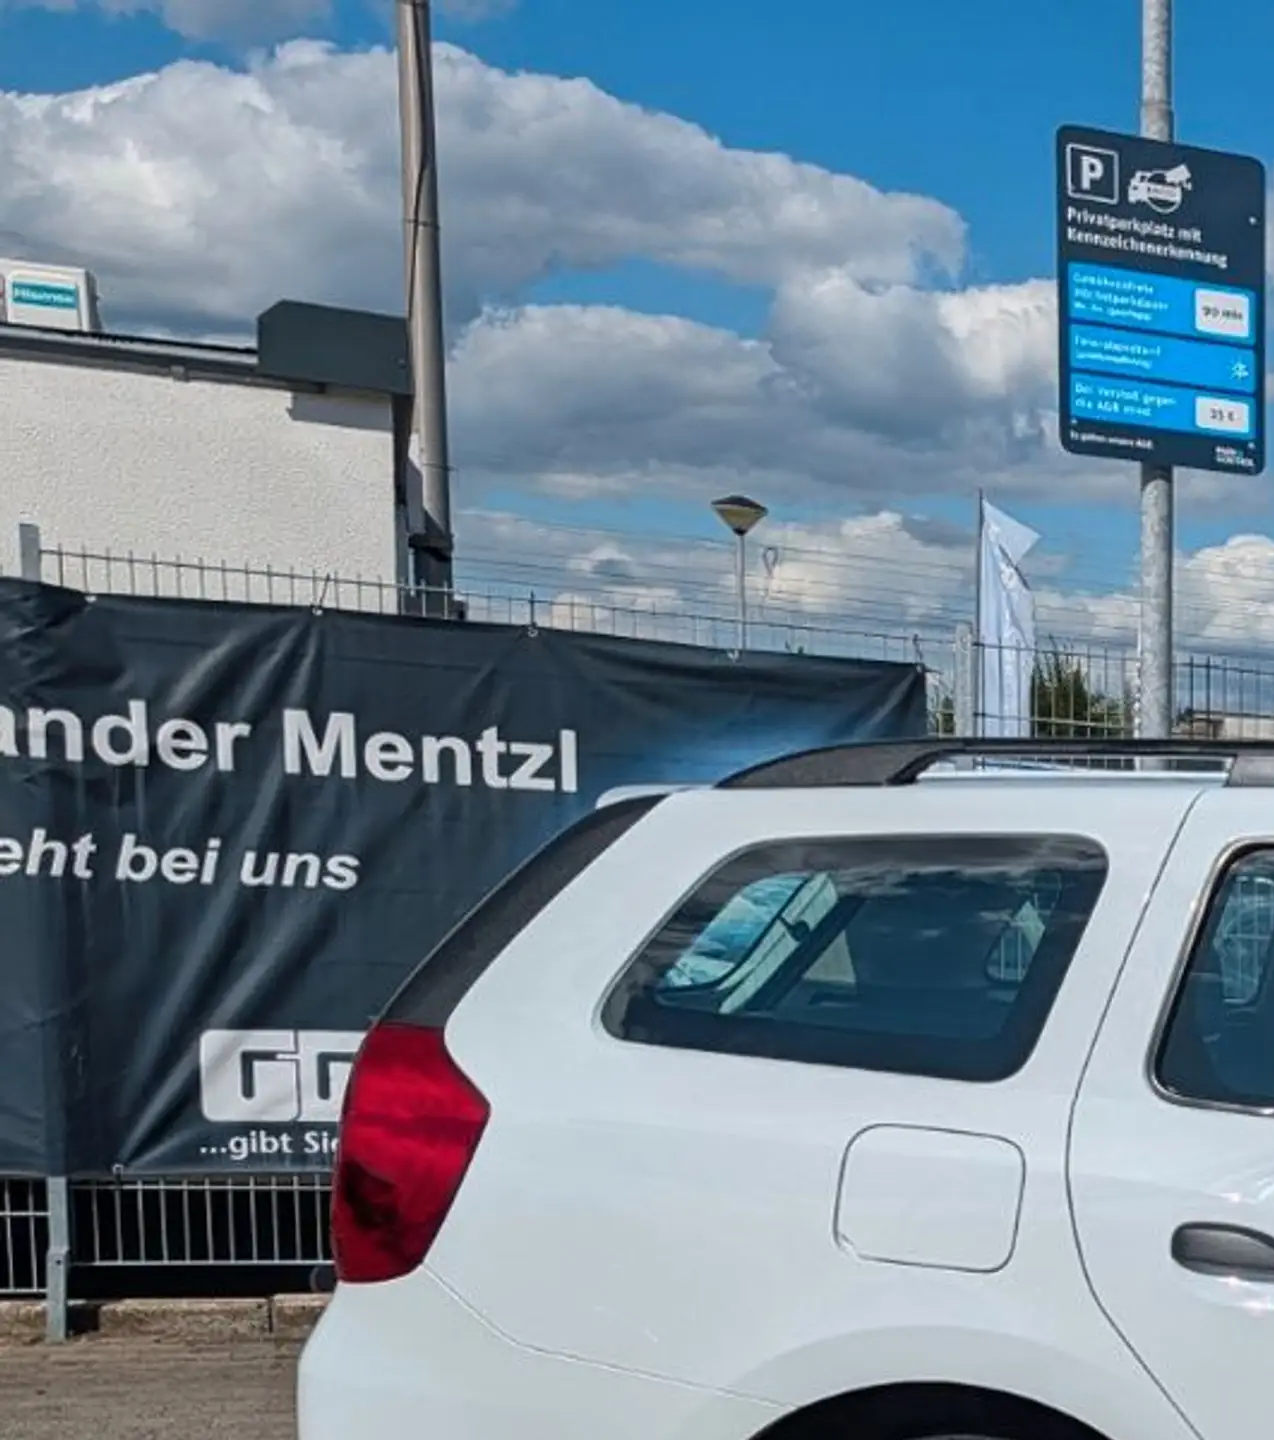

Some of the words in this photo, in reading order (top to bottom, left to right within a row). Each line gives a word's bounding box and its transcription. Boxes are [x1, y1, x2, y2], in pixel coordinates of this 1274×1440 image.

[1081, 155, 1104, 190] P
[1067, 206, 1175, 239] Privatparkplatz
[1178, 227, 1202, 243] mit
[1067, 226, 1228, 269] Kennzeichenerkennung
[283, 708, 577, 793] Mentzl
[115, 833, 222, 885] bei
[240, 850, 361, 889] uns
